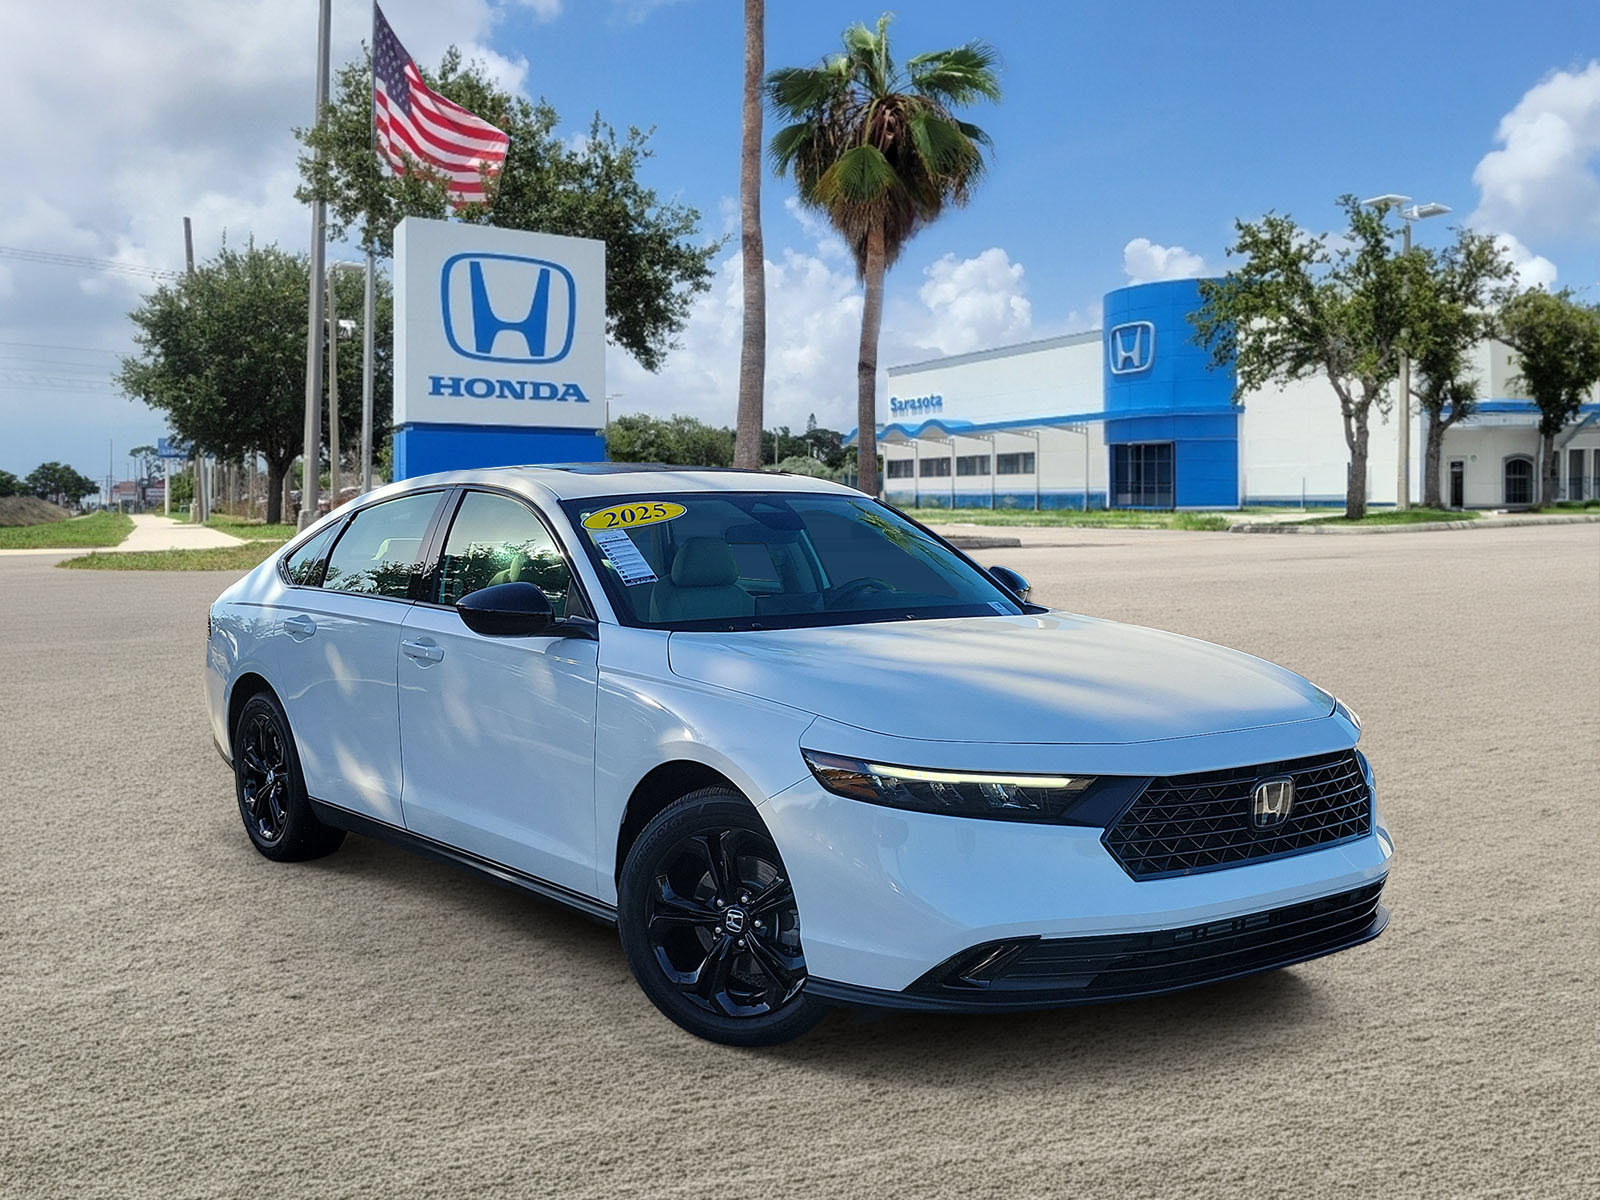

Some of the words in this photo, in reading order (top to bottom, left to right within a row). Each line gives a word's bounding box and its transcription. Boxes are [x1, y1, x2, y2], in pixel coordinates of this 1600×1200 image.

[428, 376, 590, 402] HONDA
[890, 394, 943, 411] Sarasota
[603, 504, 666, 527] 2025
